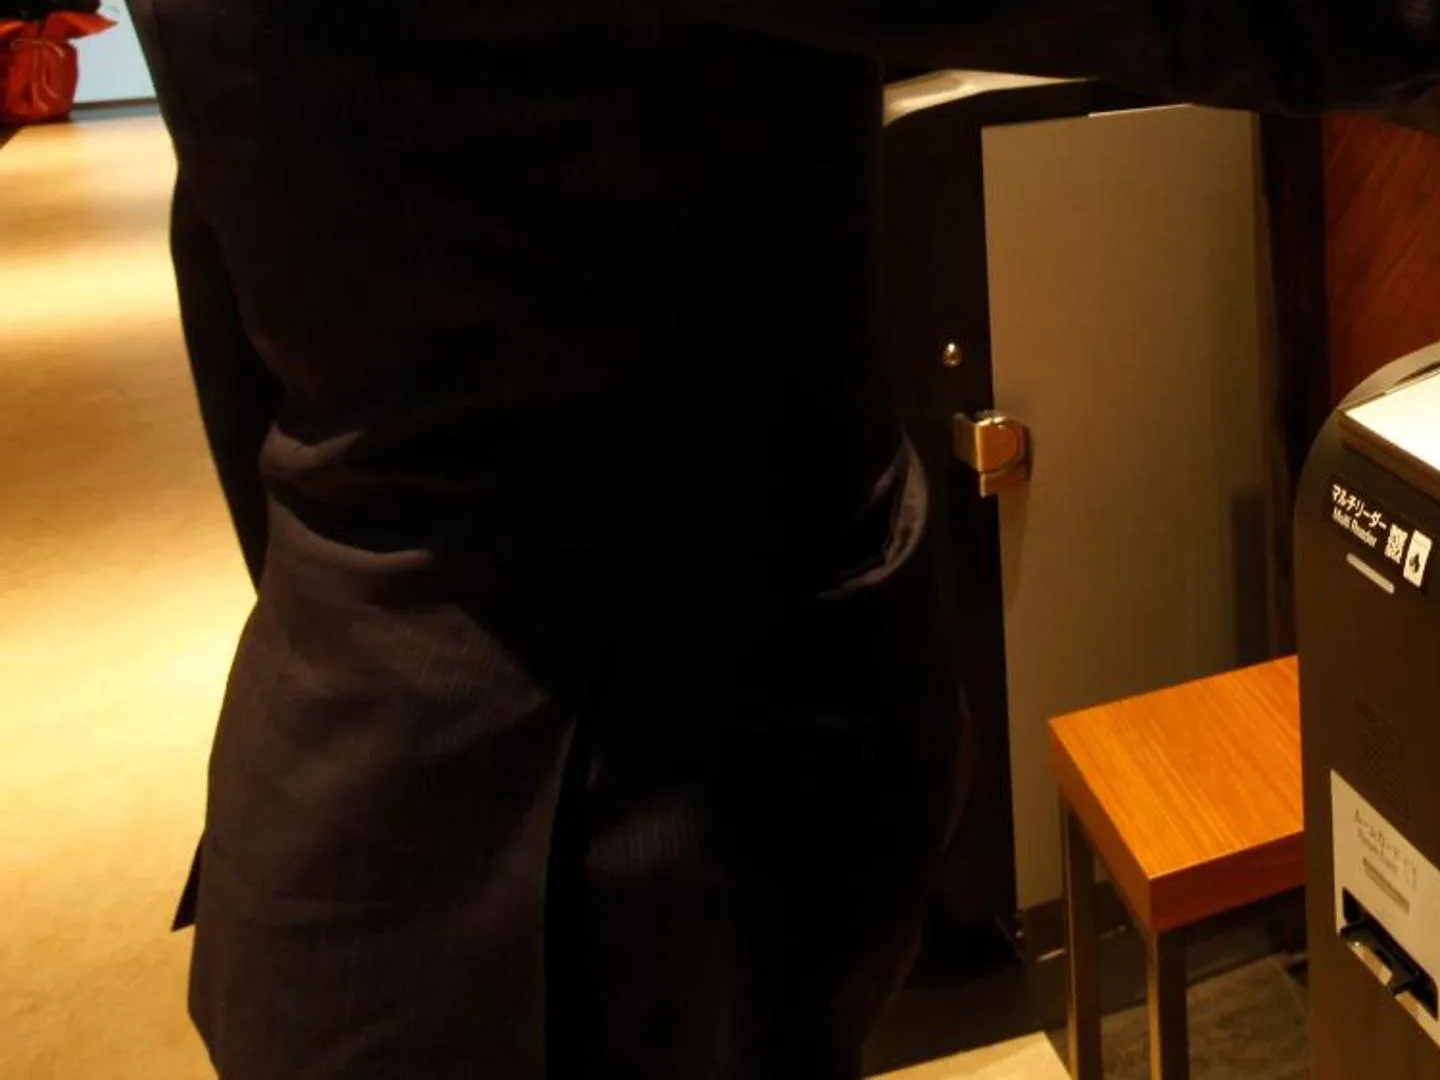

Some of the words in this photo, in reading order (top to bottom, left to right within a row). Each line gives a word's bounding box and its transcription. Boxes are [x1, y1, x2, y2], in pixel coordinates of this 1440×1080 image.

[1332, 483, 1388, 530] マルチリーダー
